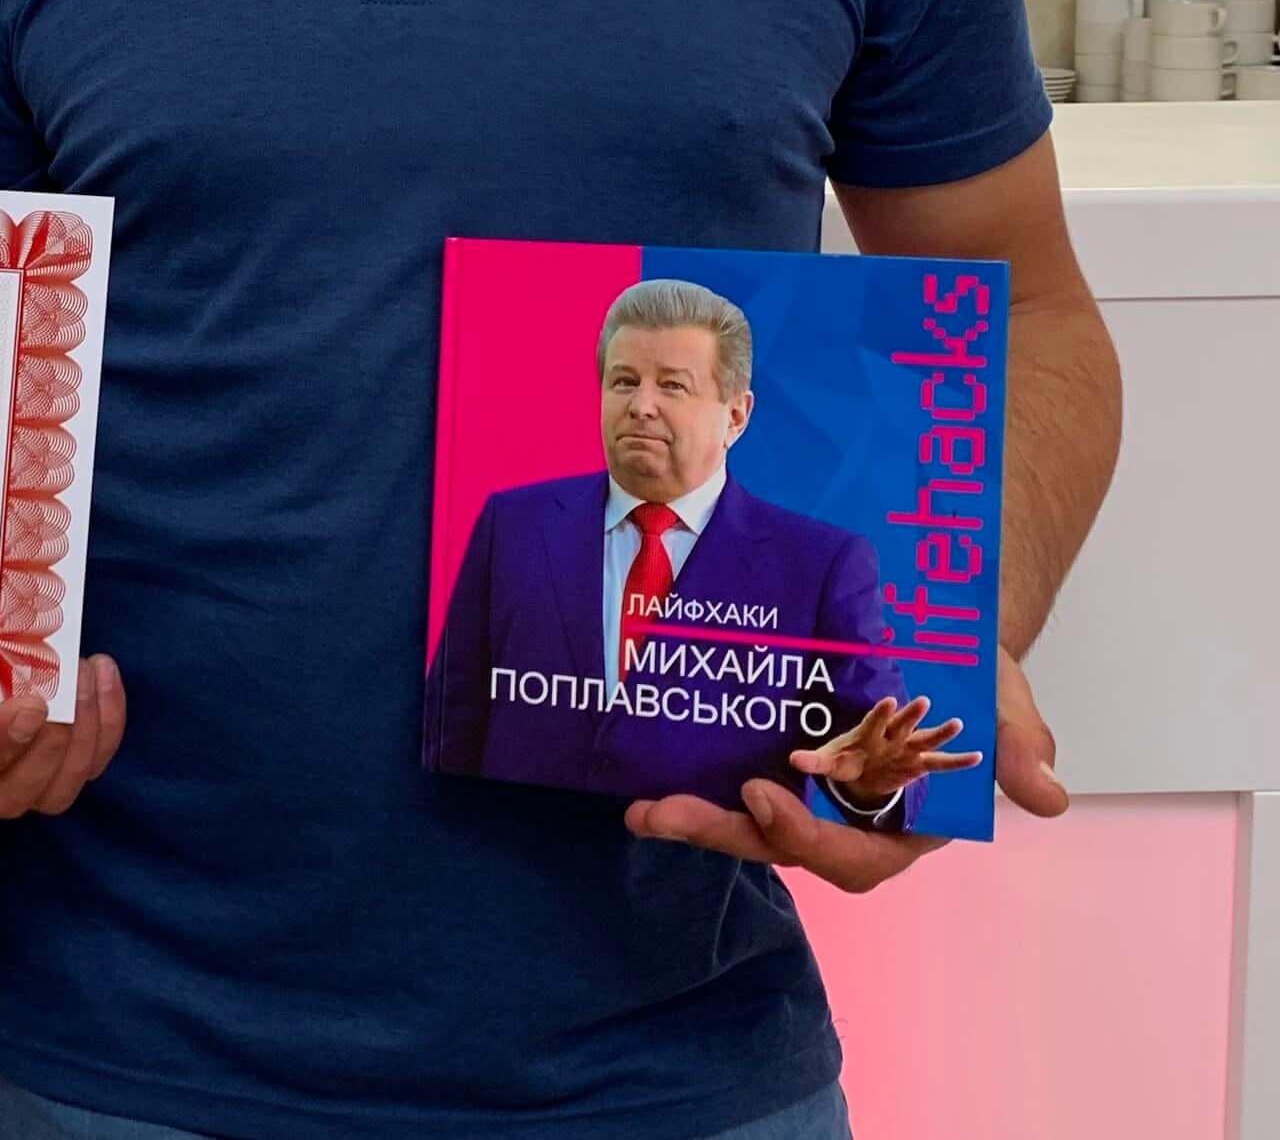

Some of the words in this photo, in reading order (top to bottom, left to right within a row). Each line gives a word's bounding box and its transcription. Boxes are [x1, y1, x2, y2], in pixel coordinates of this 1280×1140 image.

[880, 272, 990, 666] lifehacks
[626, 593, 779, 630] ЛАЙФХАКИ
[623, 638, 835, 693] МИХАЙЛА
[489, 666, 833, 737] ПОПЛАВСЬКОГО
